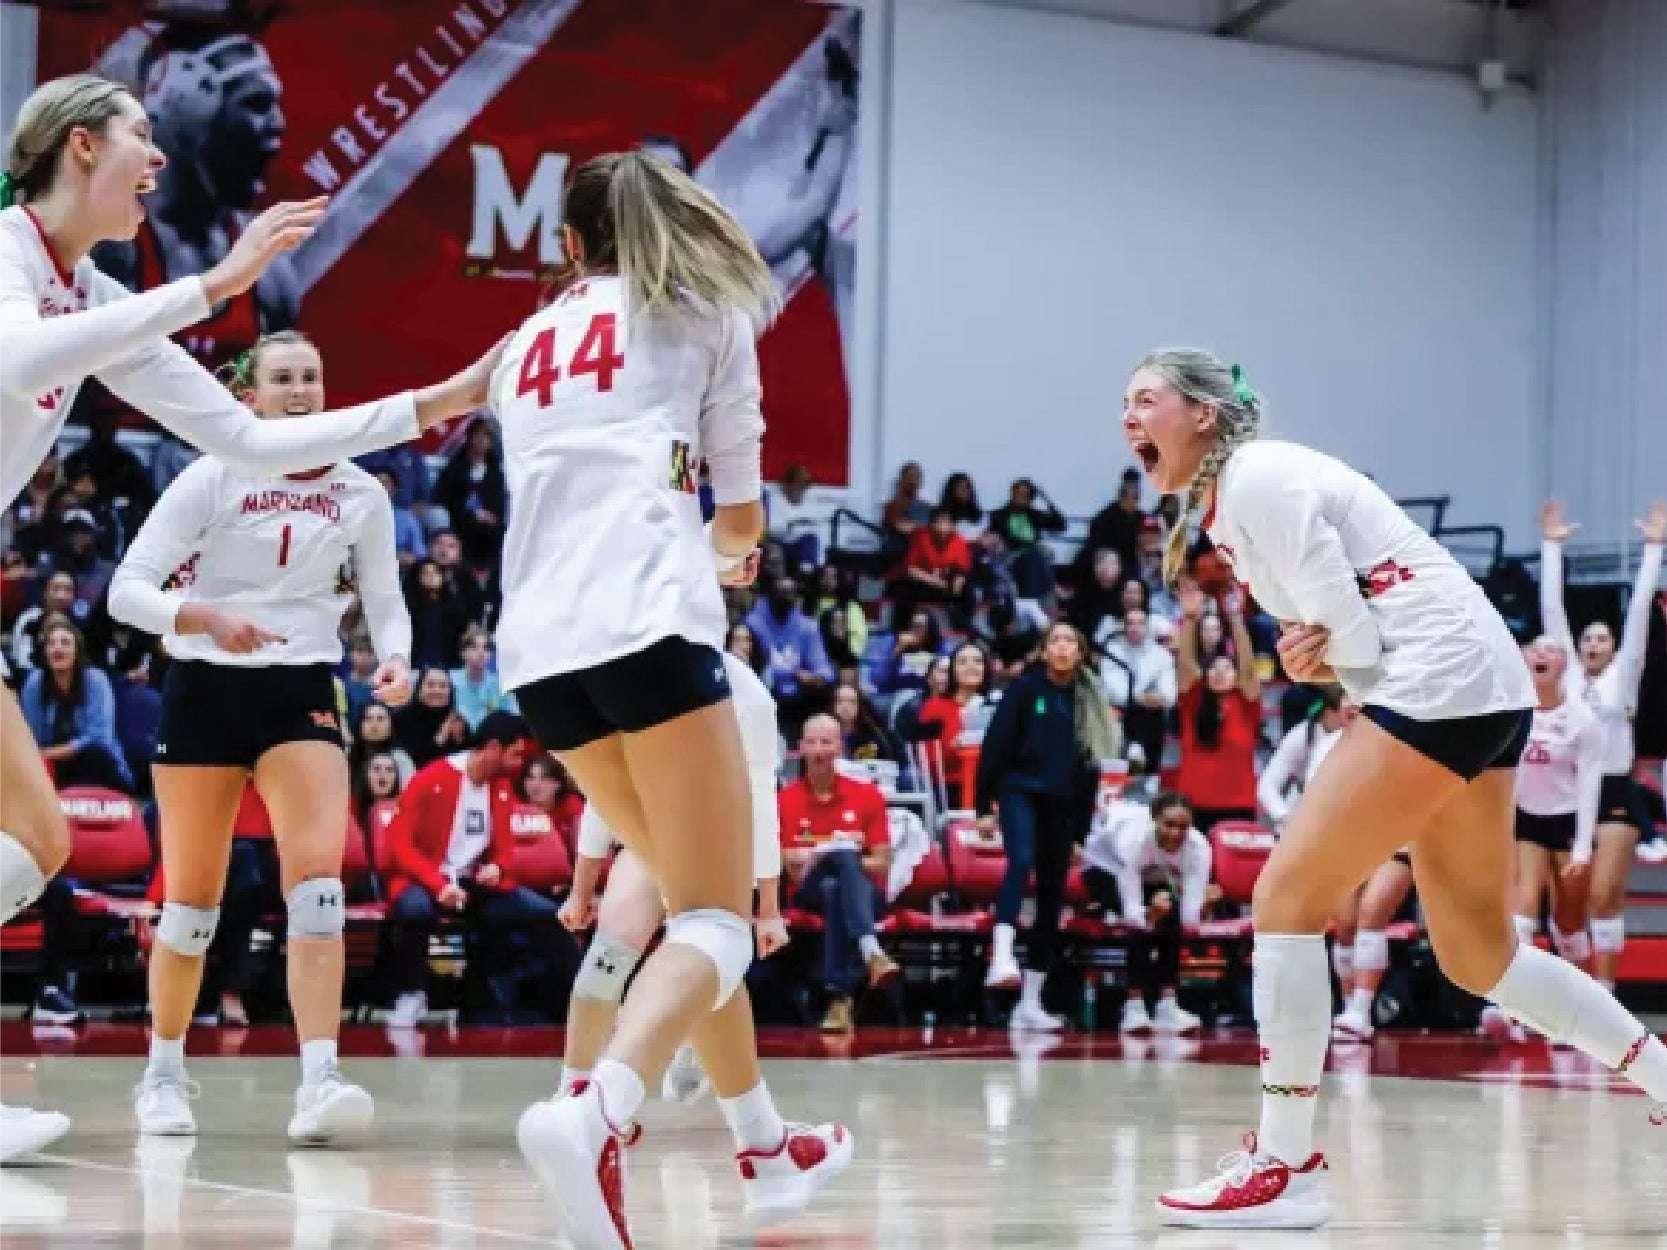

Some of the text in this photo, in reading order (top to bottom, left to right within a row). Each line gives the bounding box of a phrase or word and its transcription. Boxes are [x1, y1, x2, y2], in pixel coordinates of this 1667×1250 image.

[466, 142, 570, 265] M
[516, 312, 625, 409] 44
[277, 522, 292, 568] 1
